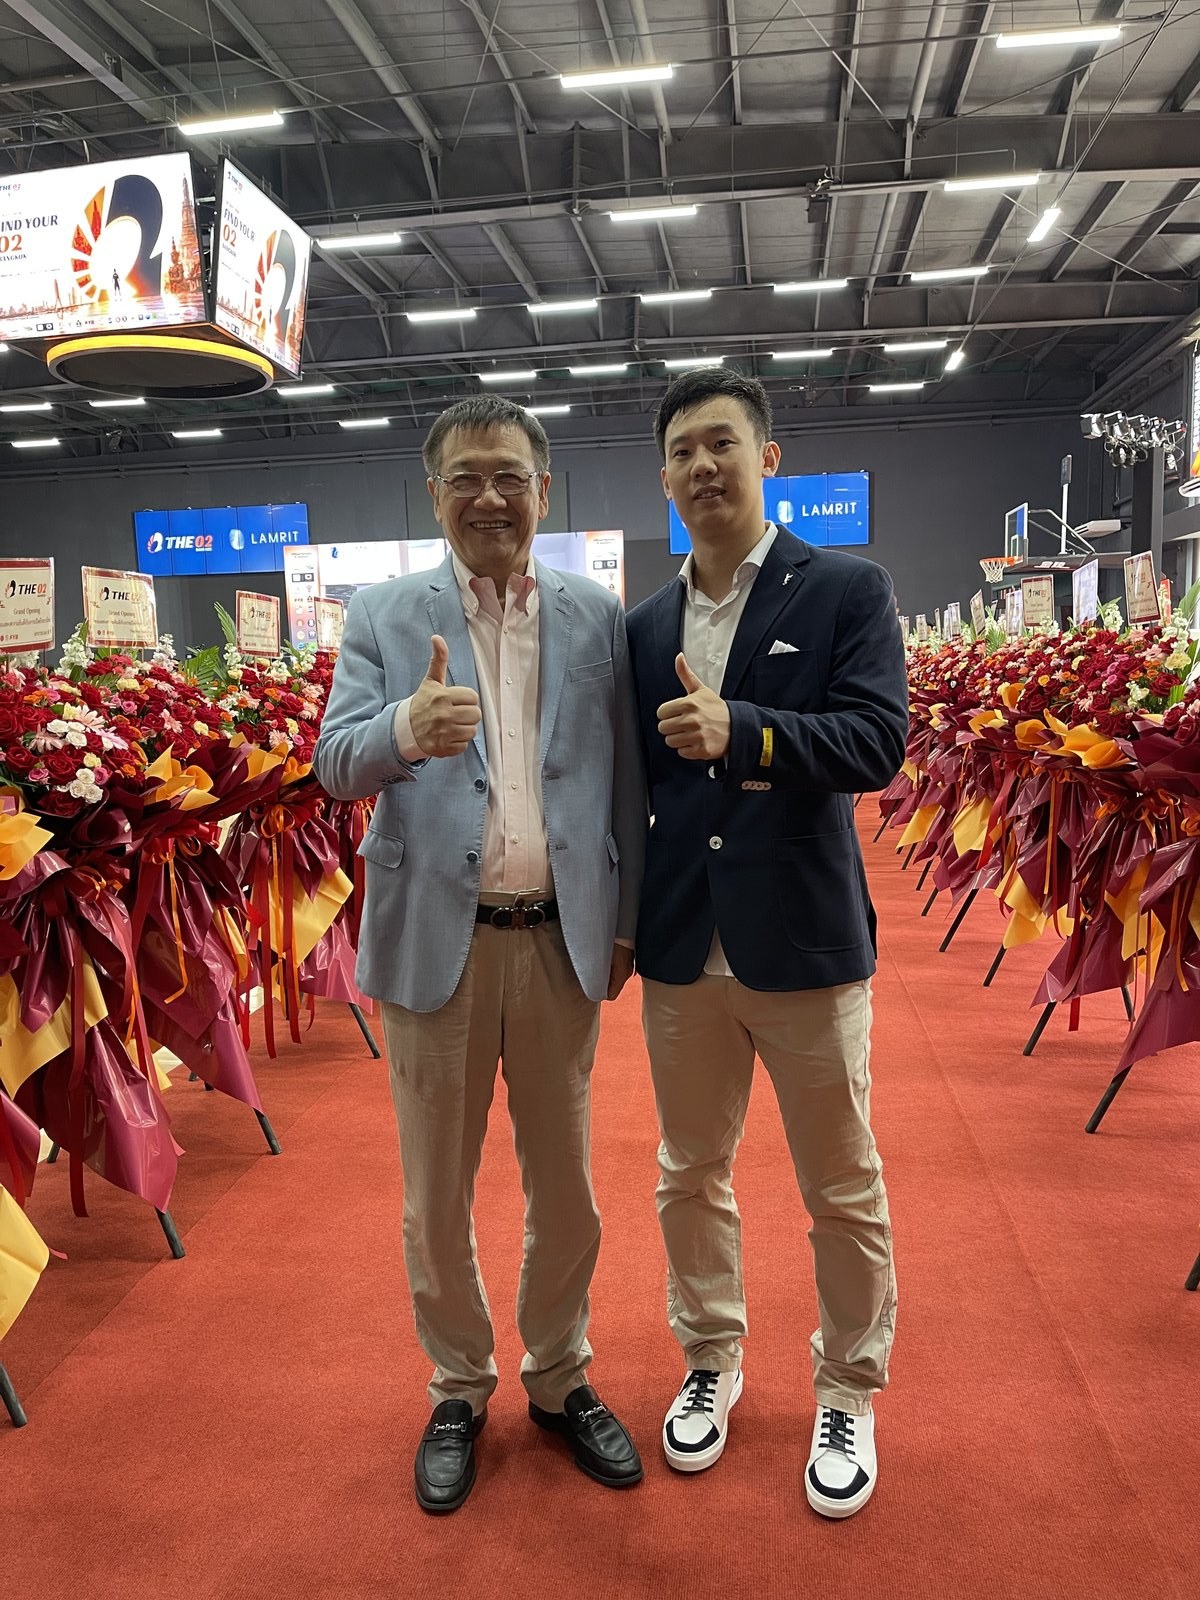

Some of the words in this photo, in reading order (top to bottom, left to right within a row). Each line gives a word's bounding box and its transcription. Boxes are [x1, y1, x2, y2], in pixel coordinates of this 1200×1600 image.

[1, 219, 22, 232] IND
[25, 215, 58, 229] YOUR
[802, 502, 857, 517] LAMRIT
[251, 531, 299, 545] LAMRIT
